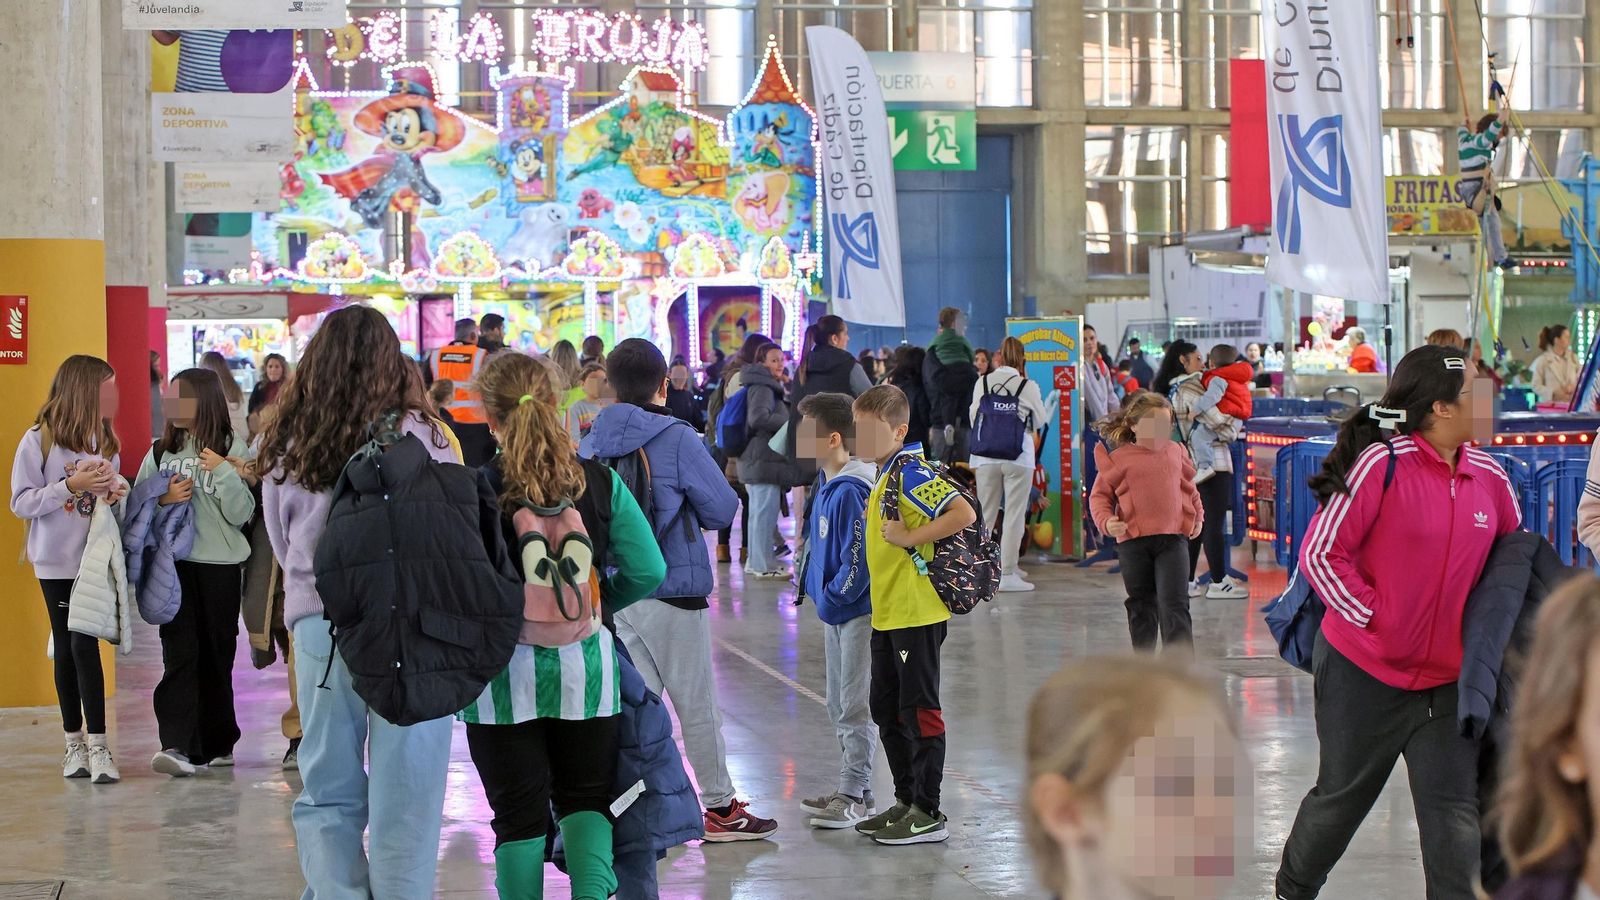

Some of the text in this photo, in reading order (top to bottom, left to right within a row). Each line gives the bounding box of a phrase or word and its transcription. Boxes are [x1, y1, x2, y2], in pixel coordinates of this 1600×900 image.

[945, 75, 957, 90] 6
[162, 107, 196, 116] ZONA
[162, 119, 229, 129] DEPORTIVA
[1394, 180, 1464, 204] FRITAS
[993, 401, 1017, 409] TOUS
[853, 519, 862, 540] CEIP
[851, 541, 862, 564] Reyes
